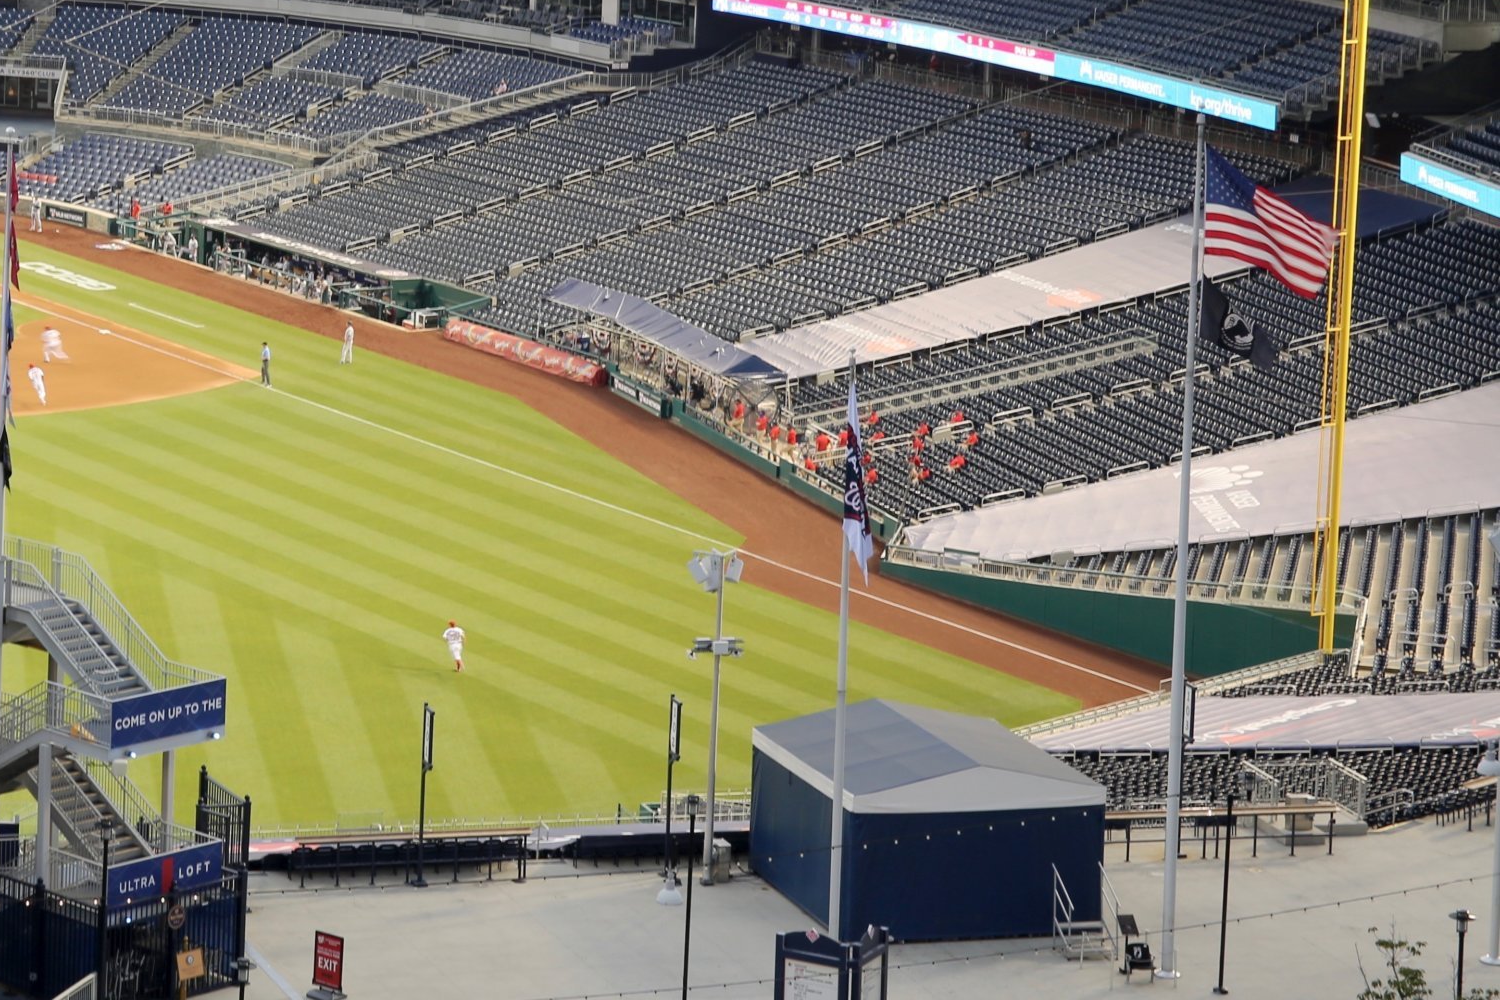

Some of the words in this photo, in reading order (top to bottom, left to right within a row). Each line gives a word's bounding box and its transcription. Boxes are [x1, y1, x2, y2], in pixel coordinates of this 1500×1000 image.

[37, 69, 56, 78] CLUB
[1094, 69, 1118, 86] KAISER
[63, 213, 83, 222] NETWORK
[115, 713, 146, 731] COME
[148, 709, 165, 723] ON
[168, 706, 182, 719] UP
[184, 702, 199, 715] TO
[201, 697, 222, 712] THE
[119, 875, 156, 894] ULTRA
[178, 860, 211, 879] LOFT
[318, 956, 338, 973] EXIT
